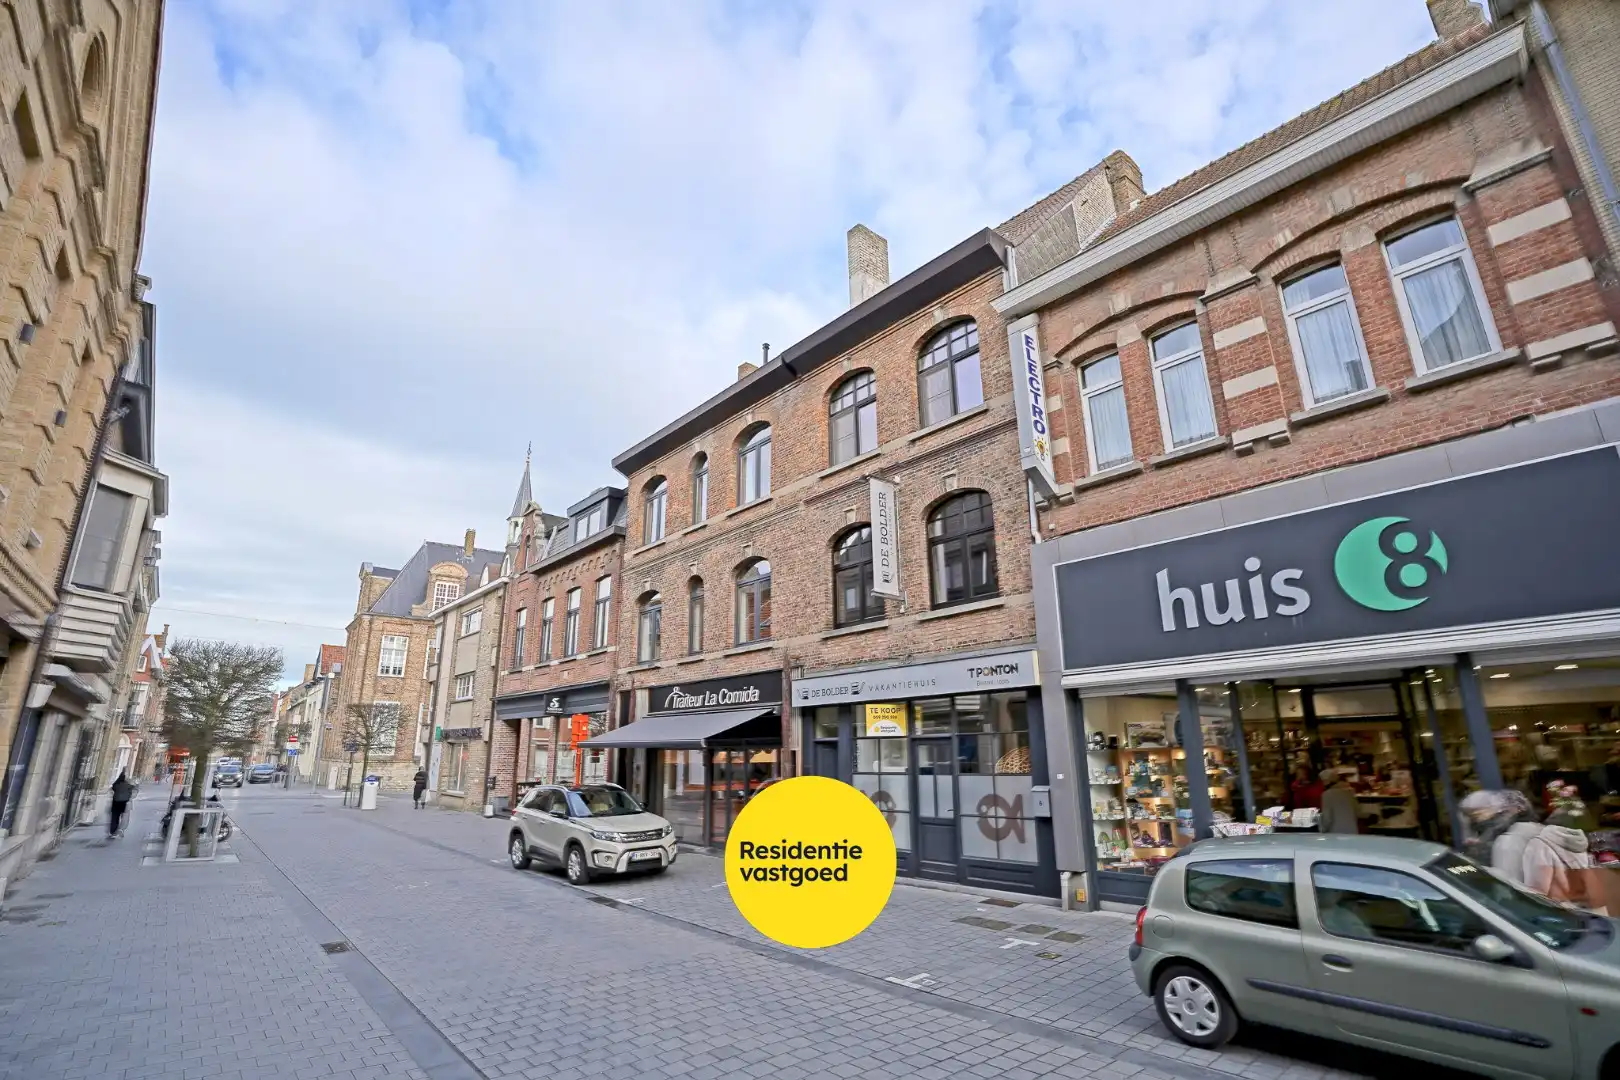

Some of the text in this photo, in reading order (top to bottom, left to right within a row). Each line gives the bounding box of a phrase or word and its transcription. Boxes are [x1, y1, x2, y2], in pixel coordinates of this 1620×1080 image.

[1024, 334, 1046, 435] ELECTRO
[878, 491, 889, 545] BOLDER
[881, 549, 890, 569] DE
[1155, 556, 1311, 632] huis
[976, 663, 1019, 678] PONTON
[672, 685, 760, 709] Traiteur La Comida
[811, 678, 937, 698] DE BOLDER VAKANTIEHUIS
